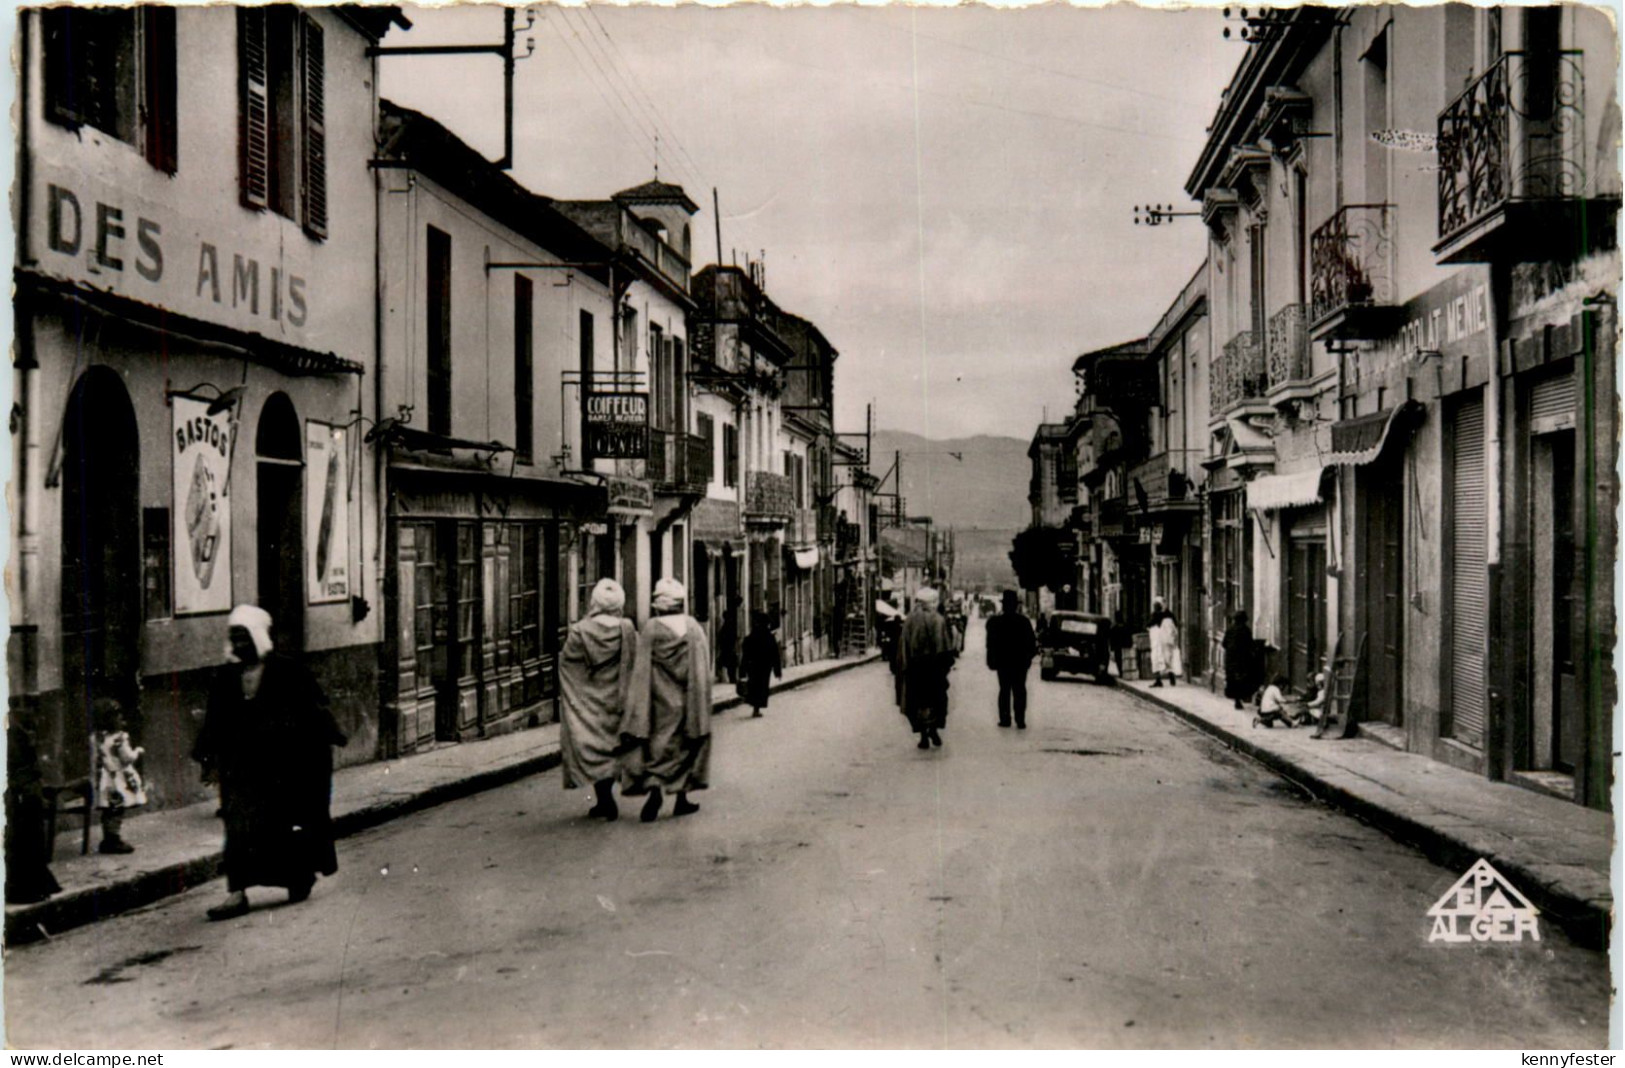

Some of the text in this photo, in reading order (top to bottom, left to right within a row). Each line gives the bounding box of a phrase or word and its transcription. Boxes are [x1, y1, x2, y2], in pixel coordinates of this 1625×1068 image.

[49, 183, 309, 327] DES AMIS
[588, 396, 646, 414] COIFFEUR
[176, 417, 227, 457] BASTOS
